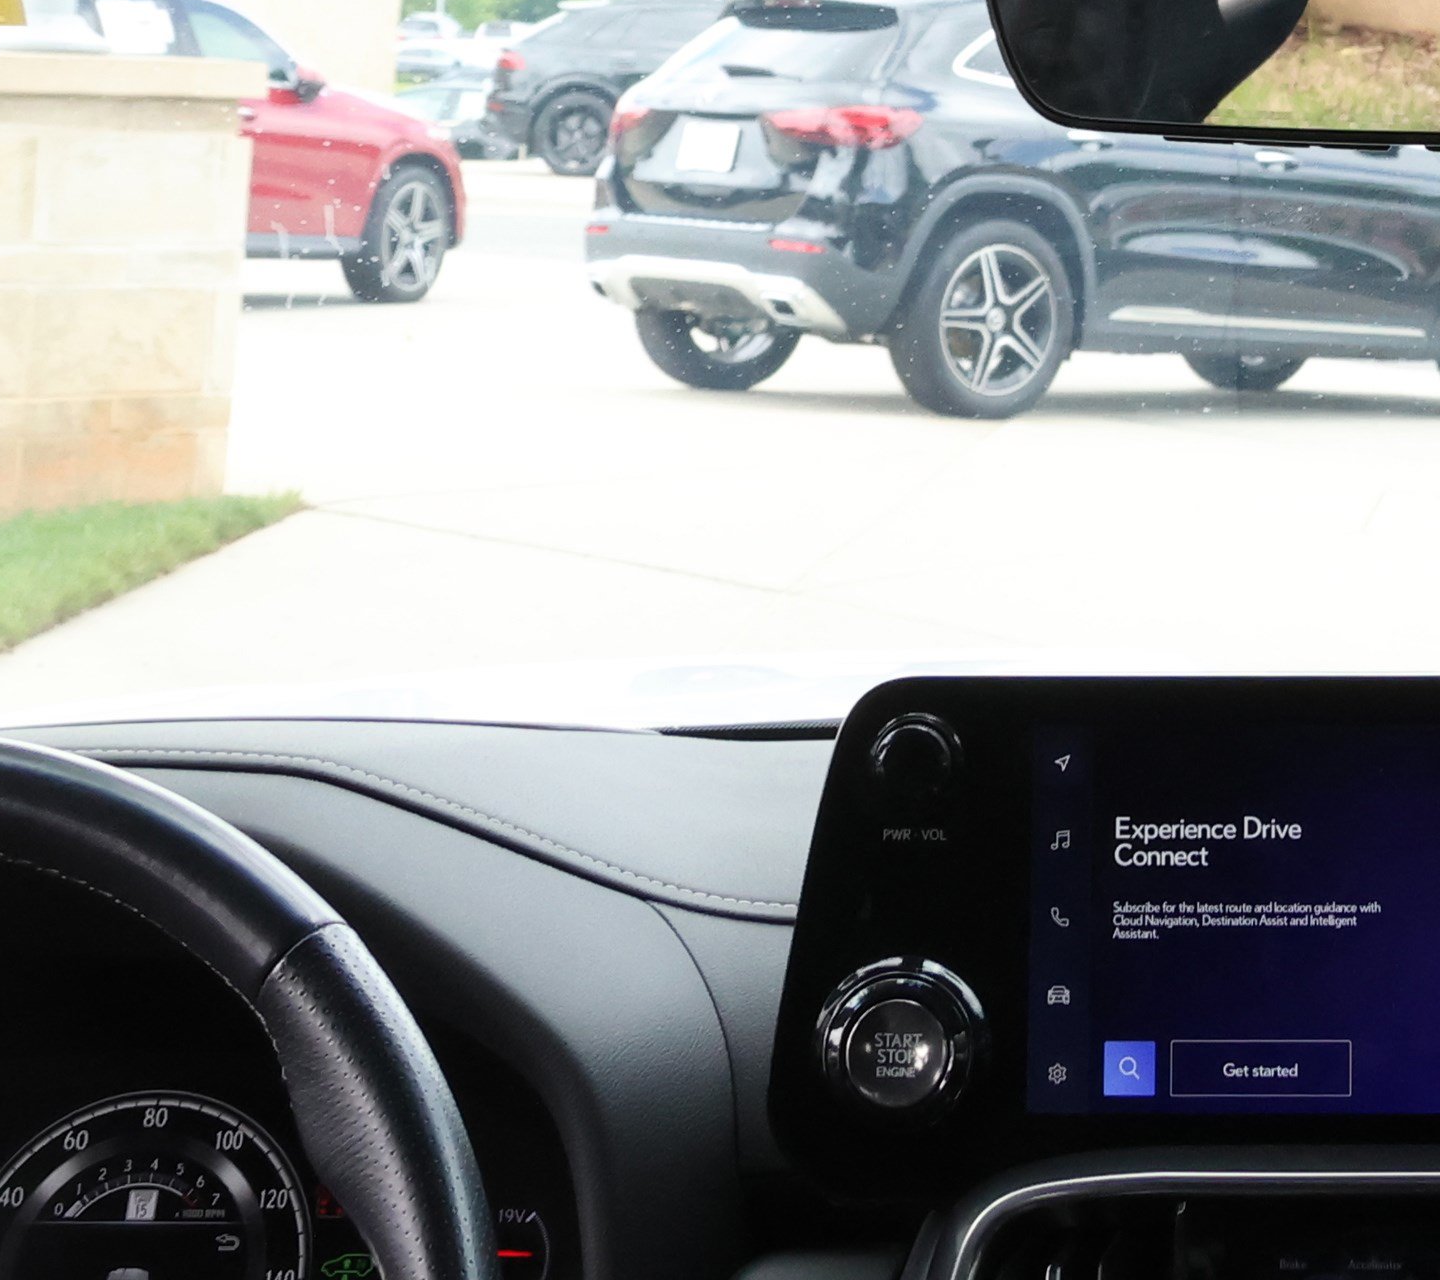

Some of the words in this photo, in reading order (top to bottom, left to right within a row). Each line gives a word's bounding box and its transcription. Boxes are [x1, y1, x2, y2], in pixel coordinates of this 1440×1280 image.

[882, 828, 912, 841] PWR
[920, 828, 947, 841] VOL
[1114, 816, 1238, 844] Experience
[1243, 815, 1303, 840] Drive
[1113, 843, 1210, 867] Connect
[1112, 901, 1161, 914] Subscribe
[1162, 901, 1177, 914] for
[1178, 901, 1195, 914] the
[1196, 901, 1224, 914] latest
[1225, 902, 1253, 914] route
[1254, 901, 1273, 914] and
[1273, 901, 1312, 914] location
[1313, 901, 1358, 917] guidance
[1359, 901, 1382, 914] with
[1112, 914, 1144, 927] Cloud
[1144, 914, 1200, 929] Navigation,
[1201, 914, 1258, 927] Destination
[1259, 914, 1289, 927] Assist
[1289, 914, 1308, 927] and
[1309, 914, 1358, 929] Intelligent
[1112, 928, 1160, 941] Assistant.
[874, 1032, 923, 1048] START
[875, 1066, 916, 1078] ENGINE
[1222, 1062, 1250, 1078] Get
[1251, 1062, 1300, 1078] started
[142, 1107, 169, 1129] 80
[62, 1129, 90, 1151] 60
[214, 1129, 244, 1151] 100
[122, 1158, 133, 1173] 3
[149, 1157, 159, 1172] 4
[175, 1162, 186, 1176] 5
[97, 1167, 109, 1182] 2
[195, 1174, 206, 1189] 6
[75, 1183, 83, 1196] 1
[209, 1192, 221, 1207] 7
[259, 1187, 290, 1210] 120
[53, 1202, 65, 1216] 0
[497, 1208, 526, 1225] 19V
